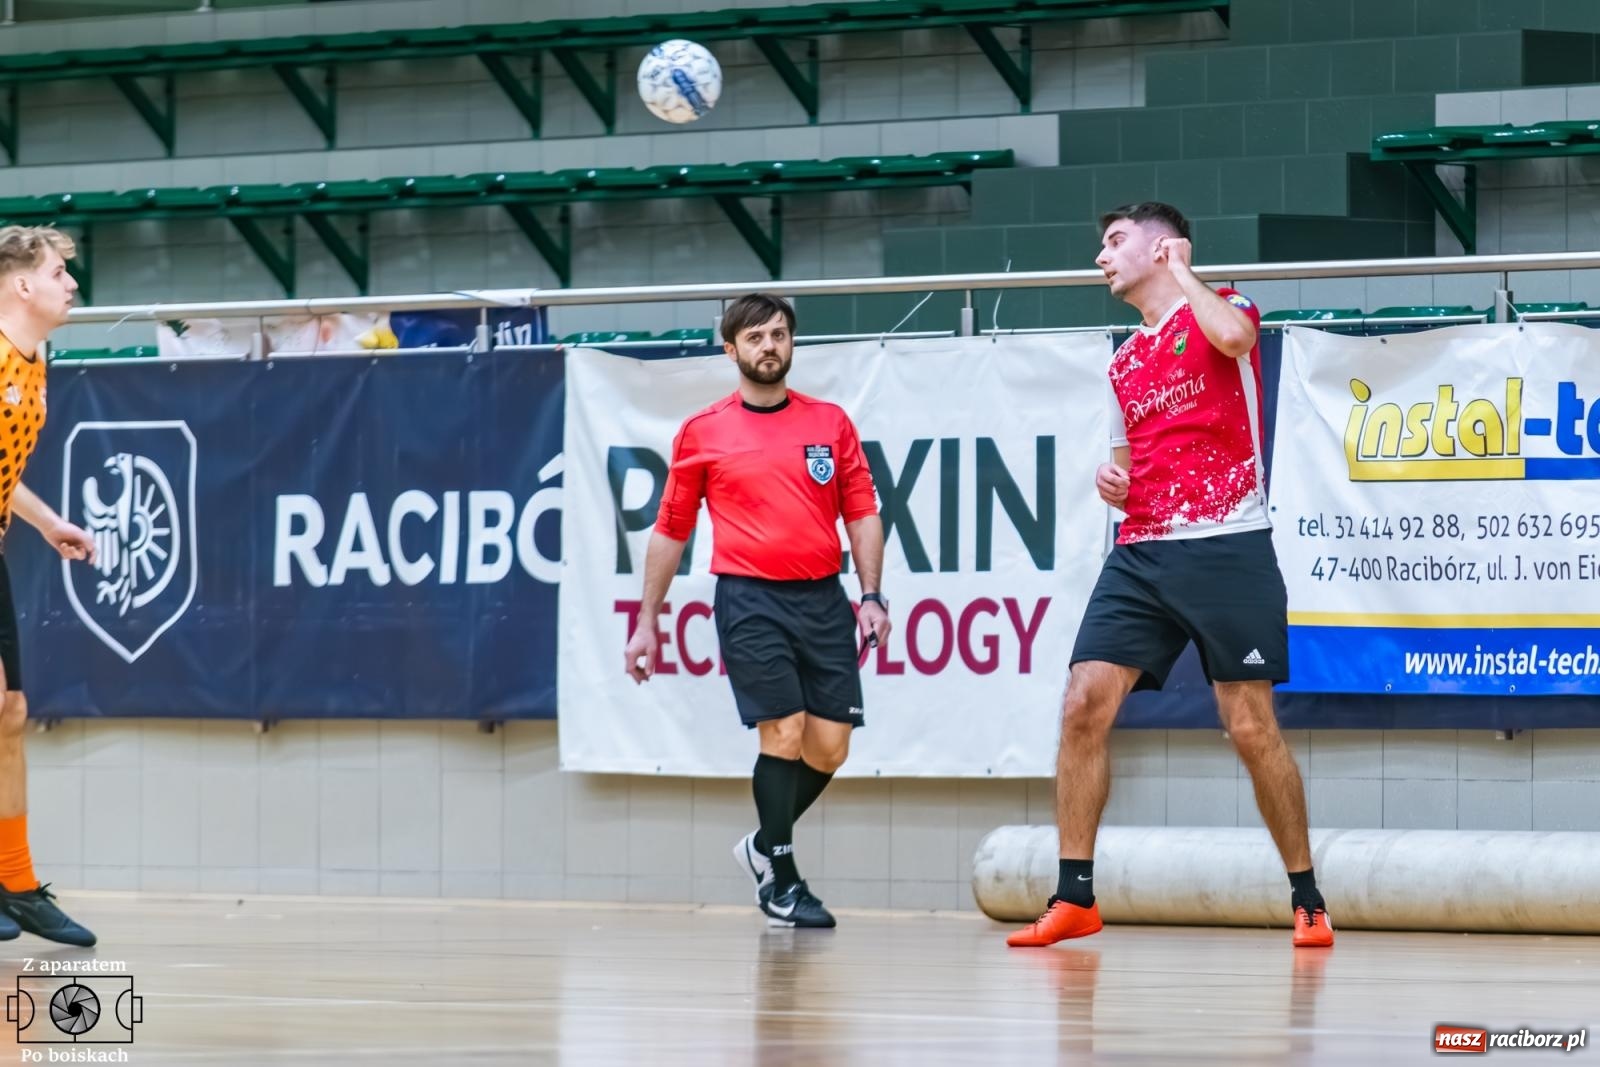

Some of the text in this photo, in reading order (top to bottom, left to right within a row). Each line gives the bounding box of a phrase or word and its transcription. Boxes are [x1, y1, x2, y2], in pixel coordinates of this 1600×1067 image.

[607, 435, 1056, 575] PXIN
[1298, 512, 1600, 541] tel. 32 414 92 88, 502 632 695
[1311, 554, 1600, 584] 47-400 Racibórz, ul. J. von Ei
[614, 597, 1053, 676] TECLOGY
